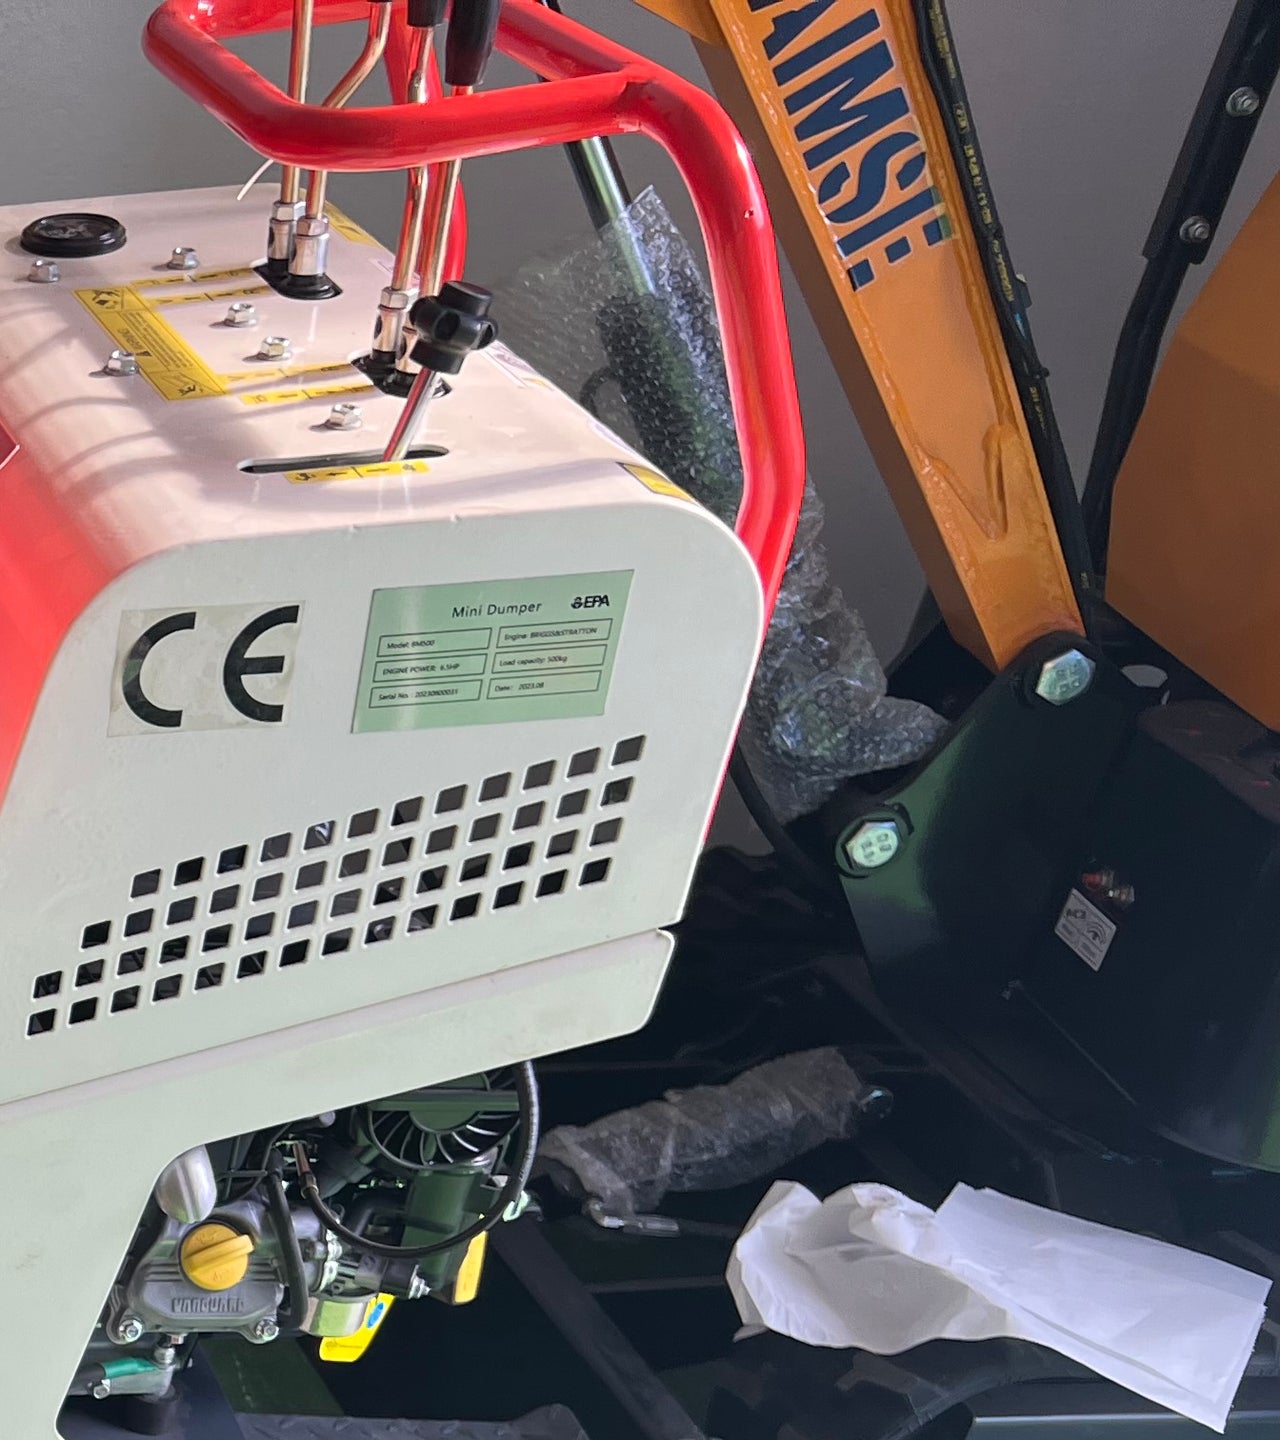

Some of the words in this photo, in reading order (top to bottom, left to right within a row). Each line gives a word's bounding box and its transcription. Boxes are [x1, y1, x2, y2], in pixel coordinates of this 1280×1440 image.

[451, 604, 483, 619] Mini
[487, 602, 543, 617] Dumper
[121, 604, 301, 729] CE
